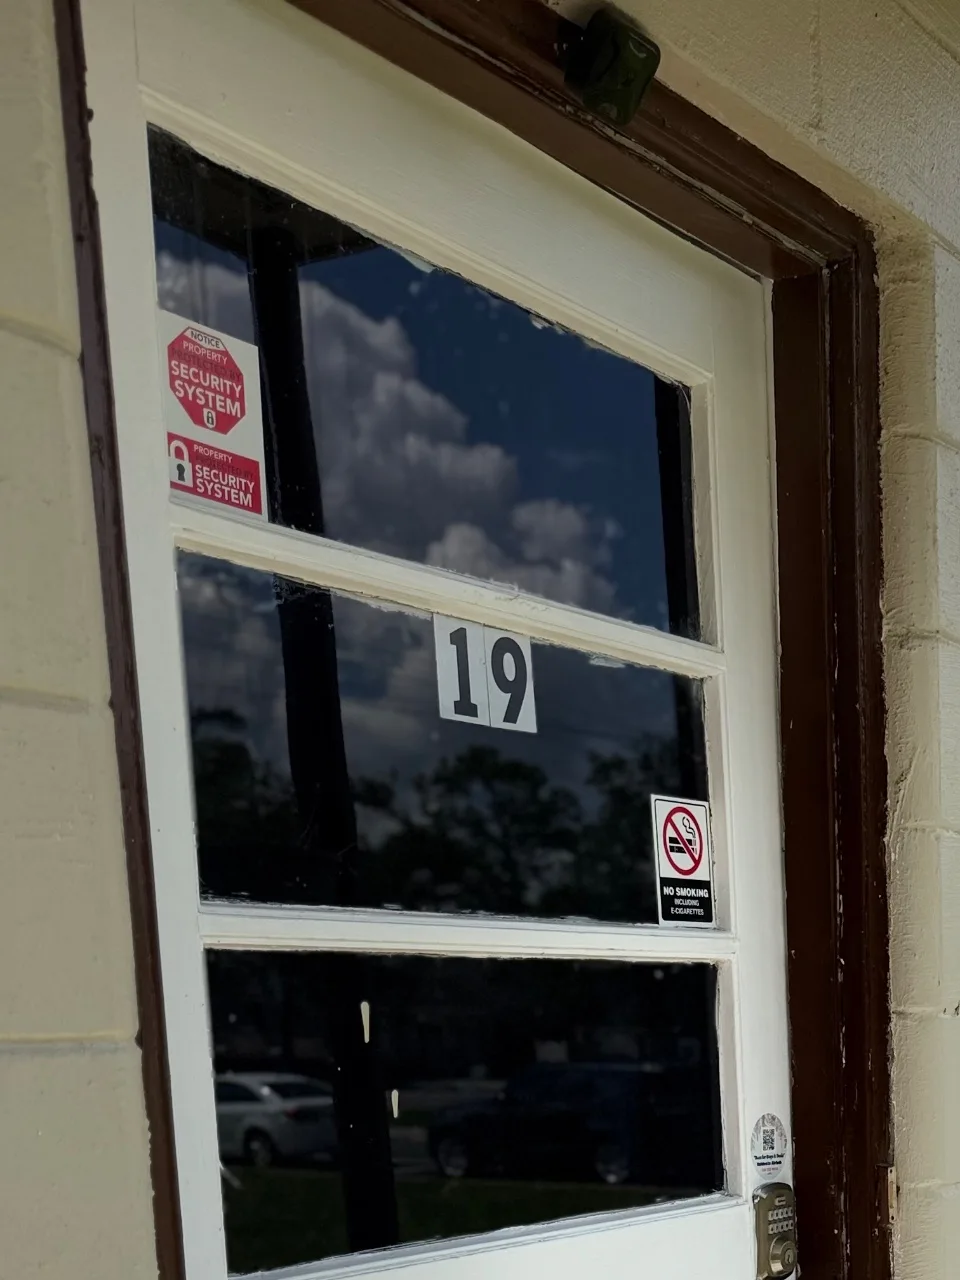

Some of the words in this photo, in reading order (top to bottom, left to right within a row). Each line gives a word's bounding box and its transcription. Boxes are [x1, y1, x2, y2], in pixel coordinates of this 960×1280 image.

[190, 330, 221, 349] NOTICE
[182, 340, 228, 365] PROPERTY
[170, 359, 242, 399] SECURITY
[174, 379, 241, 418] SYSTEM
[193, 443, 233, 464] PROPERTY
[195, 464, 255, 494] SECURITY
[196, 478, 253, 508] SYSTEM
[449, 627, 528, 724] 19
[663, 886, 675, 896] NO
[675, 887, 709, 898] SMOKING
[674, 898, 700, 907] INCLUDING
[670, 906, 705, 916] E-CIGARETTES
